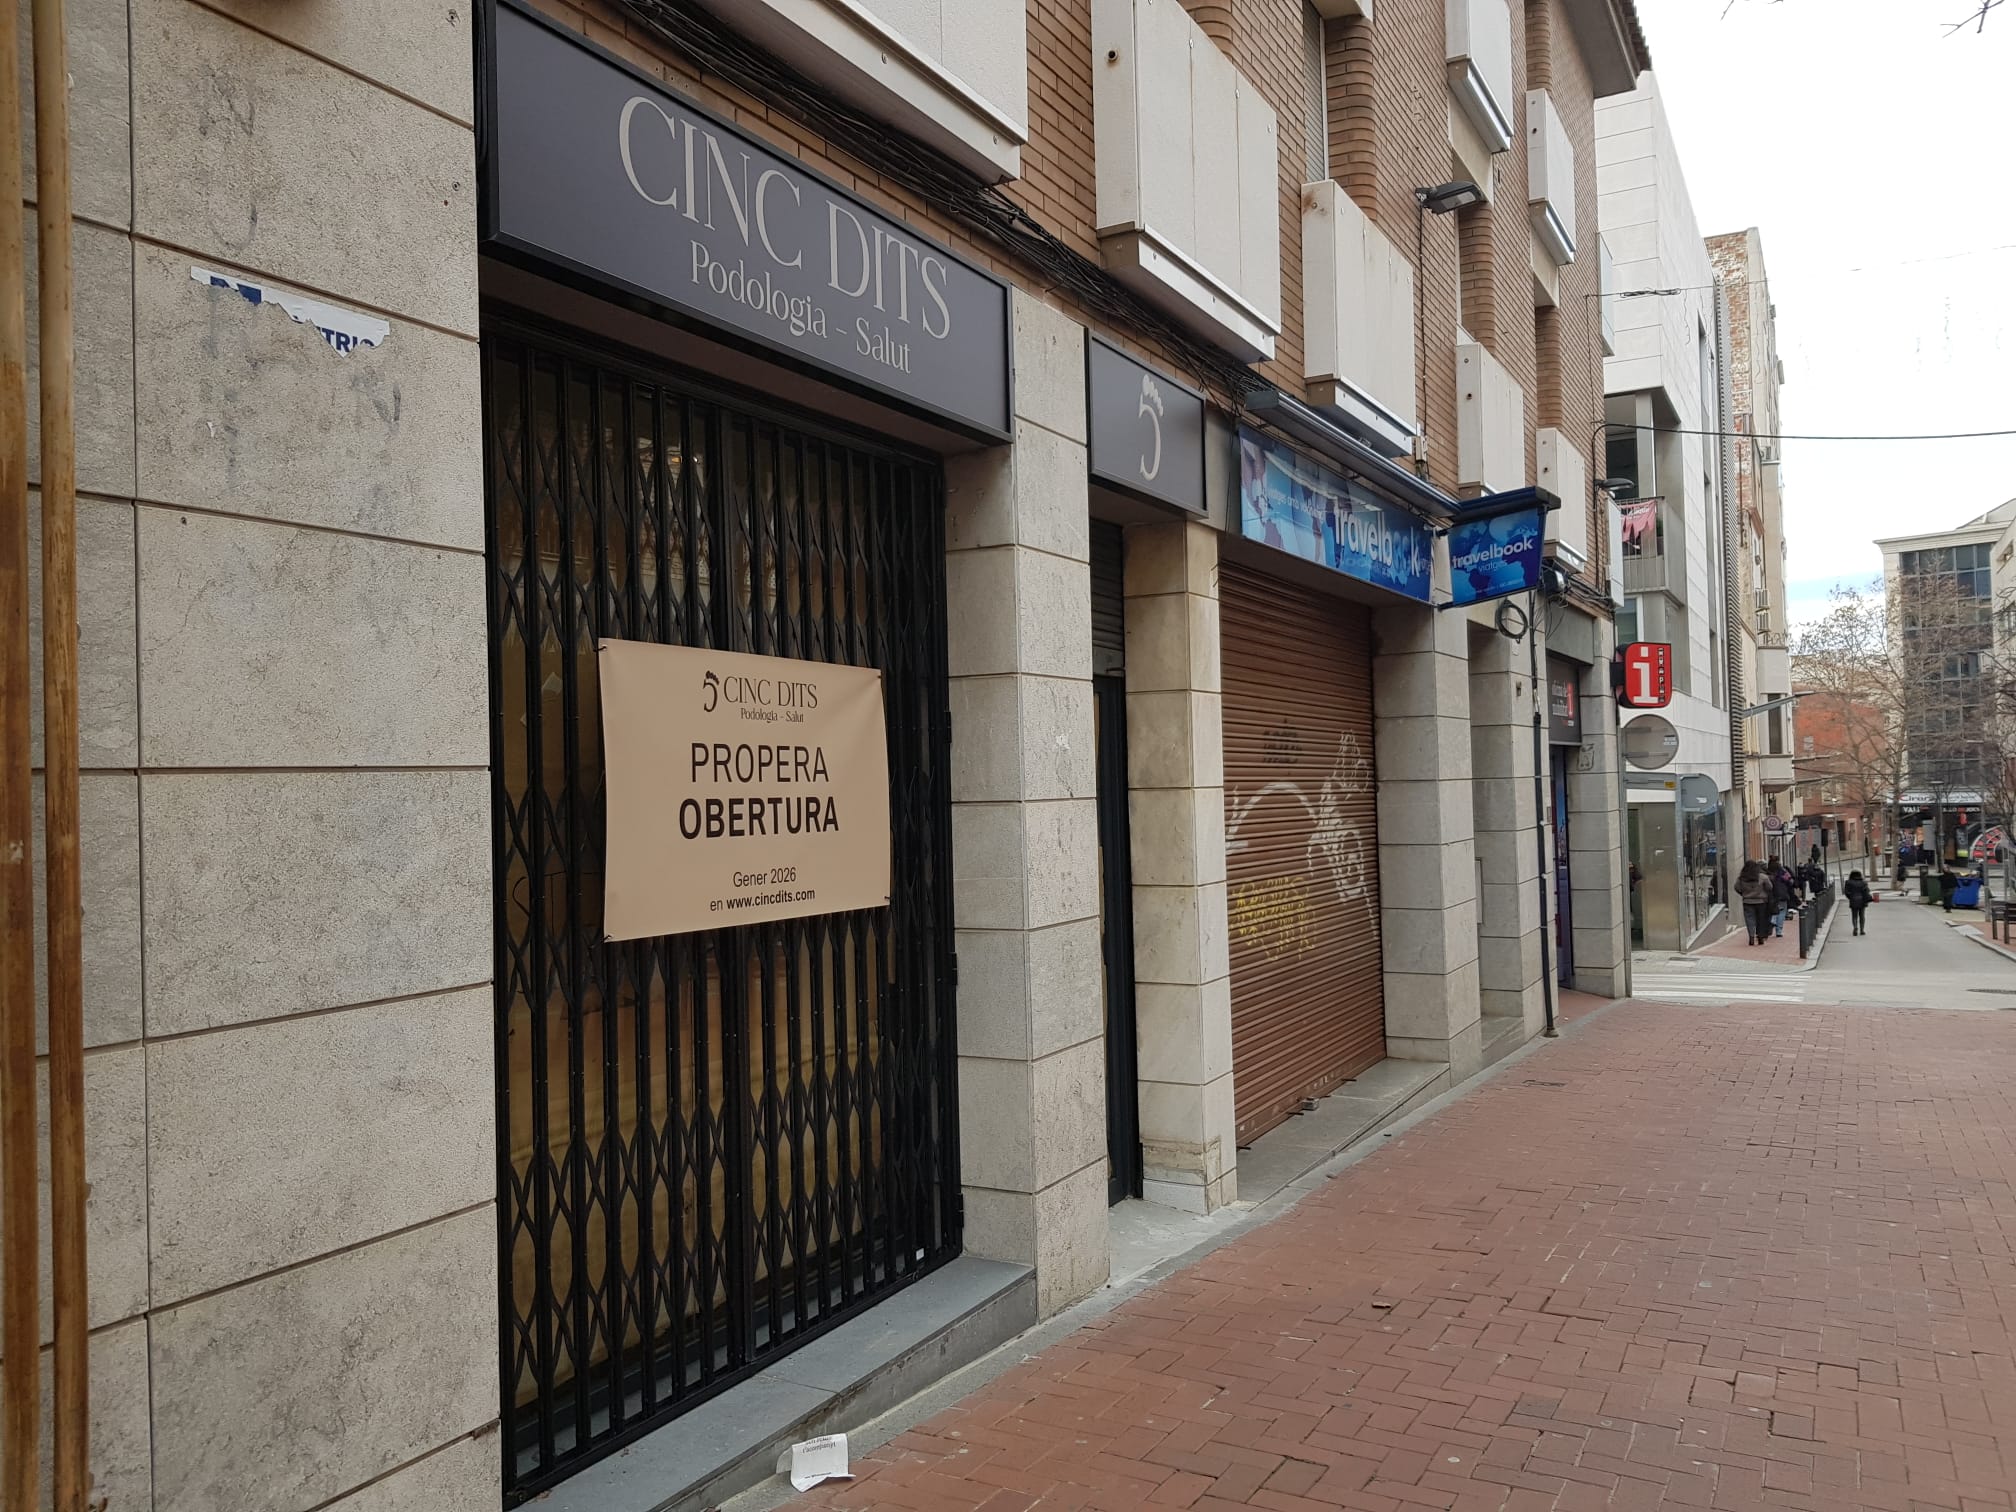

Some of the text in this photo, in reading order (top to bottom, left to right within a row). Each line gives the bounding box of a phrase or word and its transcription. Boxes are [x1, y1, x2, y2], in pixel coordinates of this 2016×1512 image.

[619, 96, 950, 340] CINC DITS
[691, 241, 827, 339] Podologia
[857, 320, 912, 374] Salut
[1452, 536, 1533, 568] travelbook
[723, 675, 771, 706] CINC
[778, 681, 818, 709] DITS
[740, 708, 778, 723] Podologia
[786, 710, 804, 723] Salut
[691, 742, 829, 783] PROPERA
[679, 796, 839, 840] OBERTURA
[733, 867, 797, 887] Gener 2026
[710, 888, 815, 911] en www.cincdits.com
